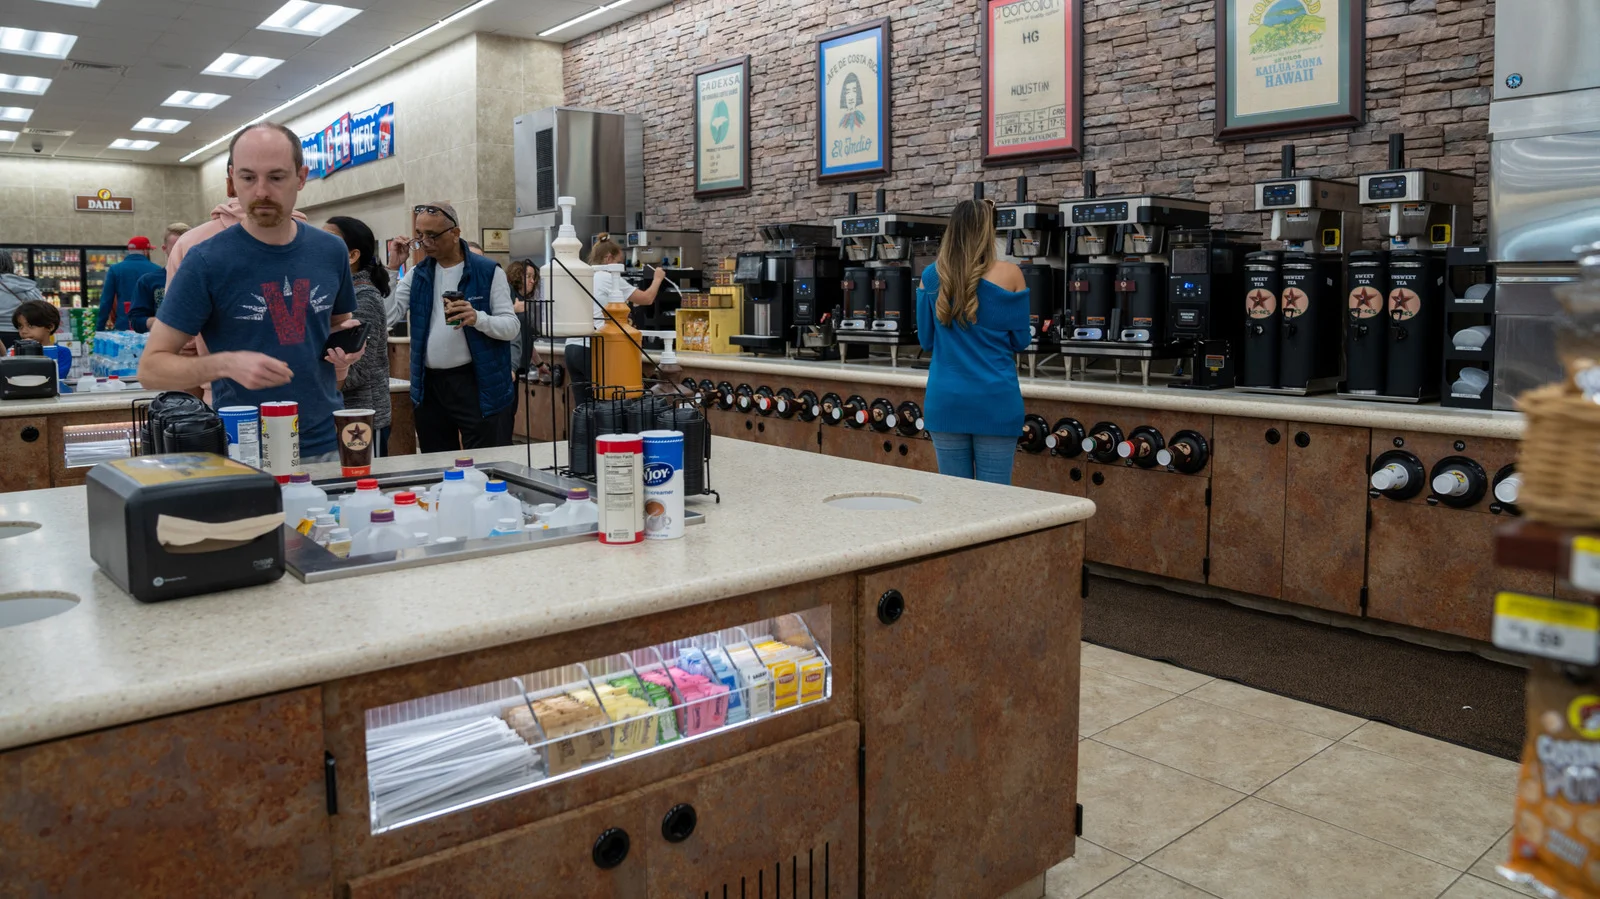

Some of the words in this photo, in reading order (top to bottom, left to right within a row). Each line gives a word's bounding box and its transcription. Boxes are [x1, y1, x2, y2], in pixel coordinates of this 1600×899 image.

[1022, 30, 1040, 44] HG
[838, 57, 847, 69] DE
[847, 53, 866, 65] COSTA
[866, 58, 878, 74] RIC
[1255, 56, 1323, 77] KAILUA-KONA
[1265, 67, 1314, 88] HAWAII
[1011, 81, 1050, 97] HOUSTON
[352, 121, 376, 157] HERE
[831, 139, 843, 159] El
[843, 133, 873, 157] Indio
[88, 199, 121, 210] DAIRY
